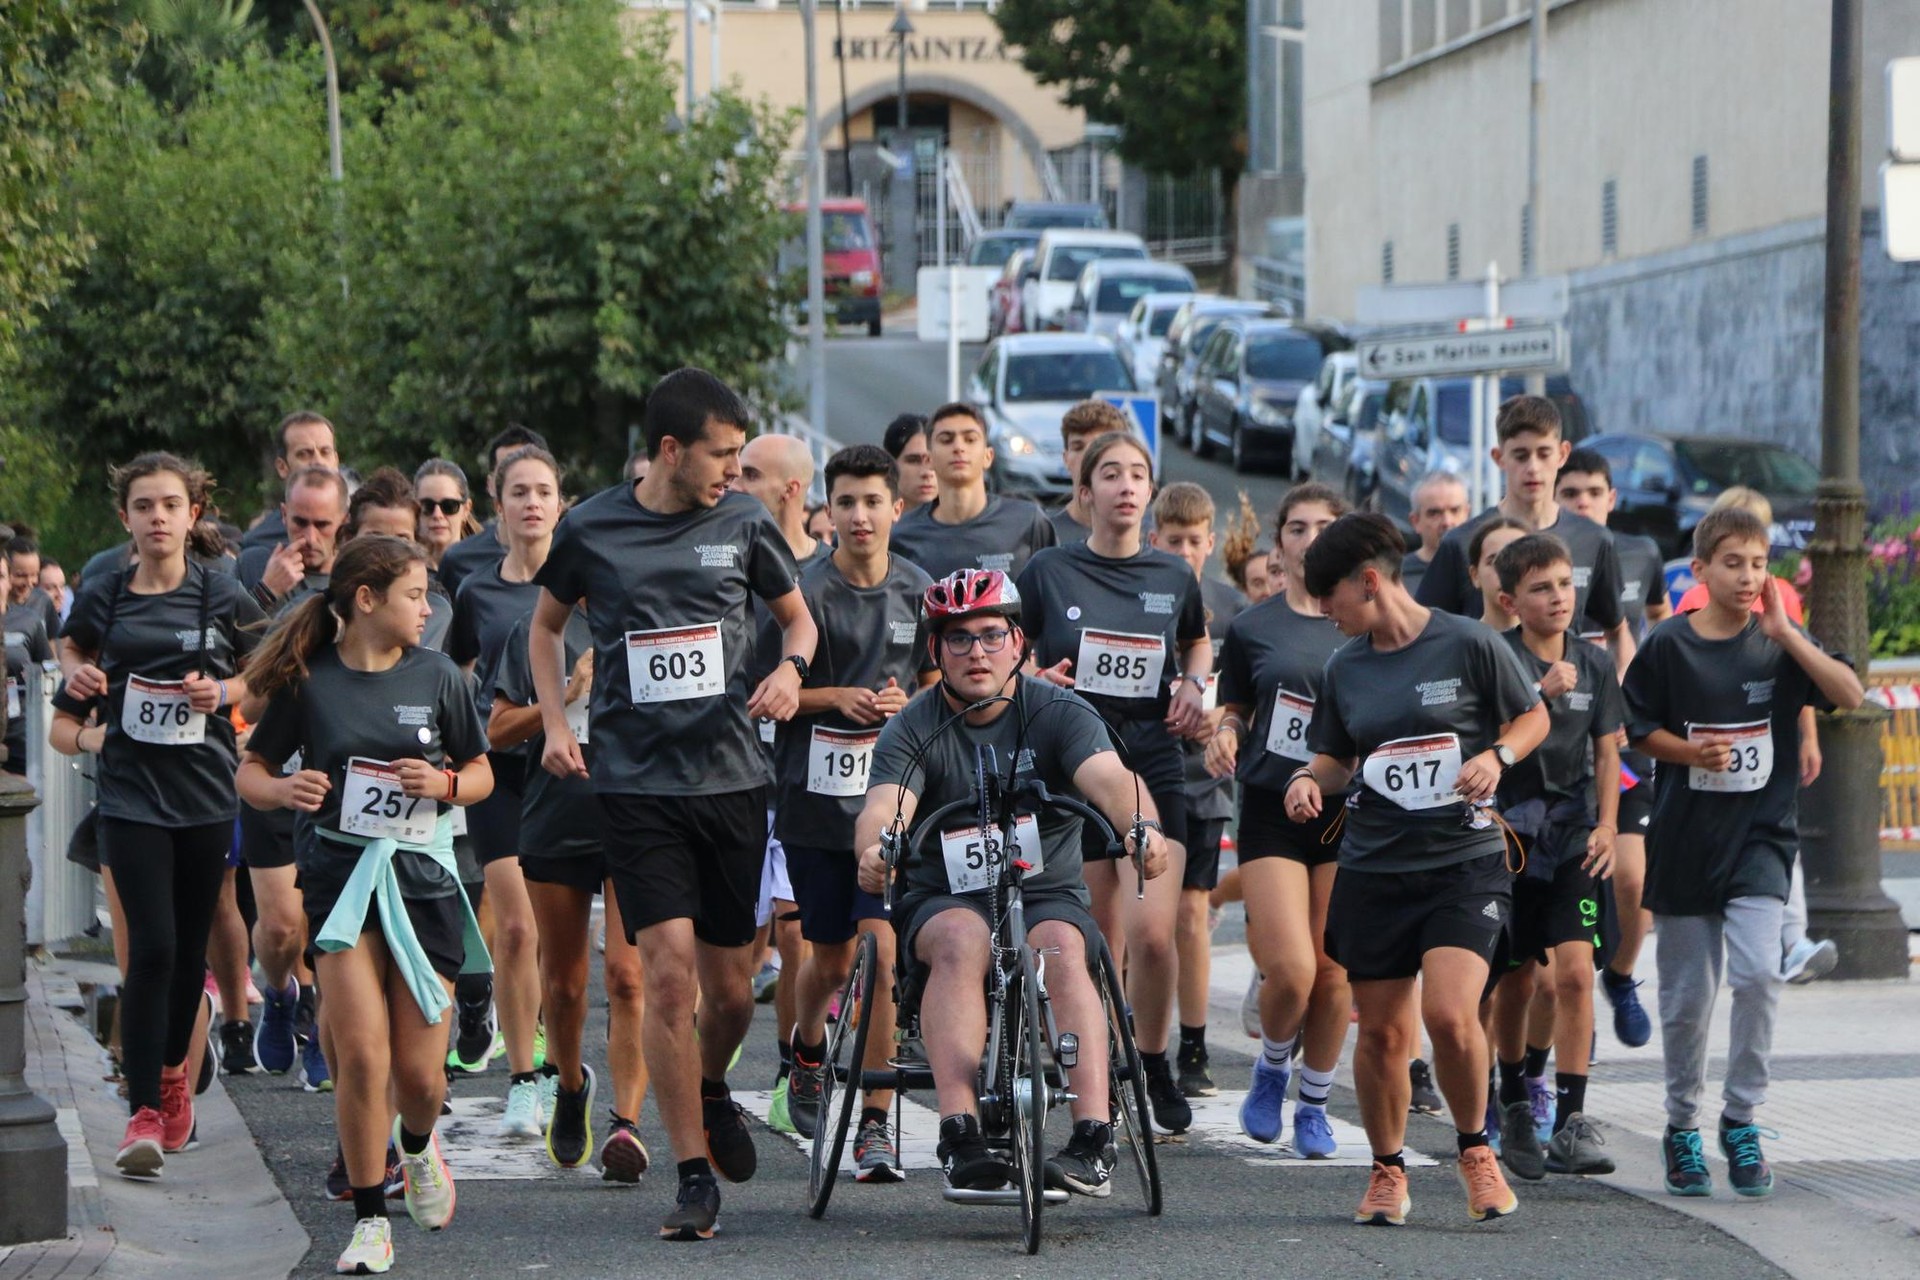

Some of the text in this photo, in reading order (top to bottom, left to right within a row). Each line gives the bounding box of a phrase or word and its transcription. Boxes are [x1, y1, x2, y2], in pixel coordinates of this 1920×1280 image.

[649, 650, 706, 682] 603
[1096, 653, 1147, 680] 885
[140, 701, 190, 726] 876
[824, 751, 867, 778] 191
[1384, 760, 1441, 792] 617
[361, 786, 421, 821] 257
